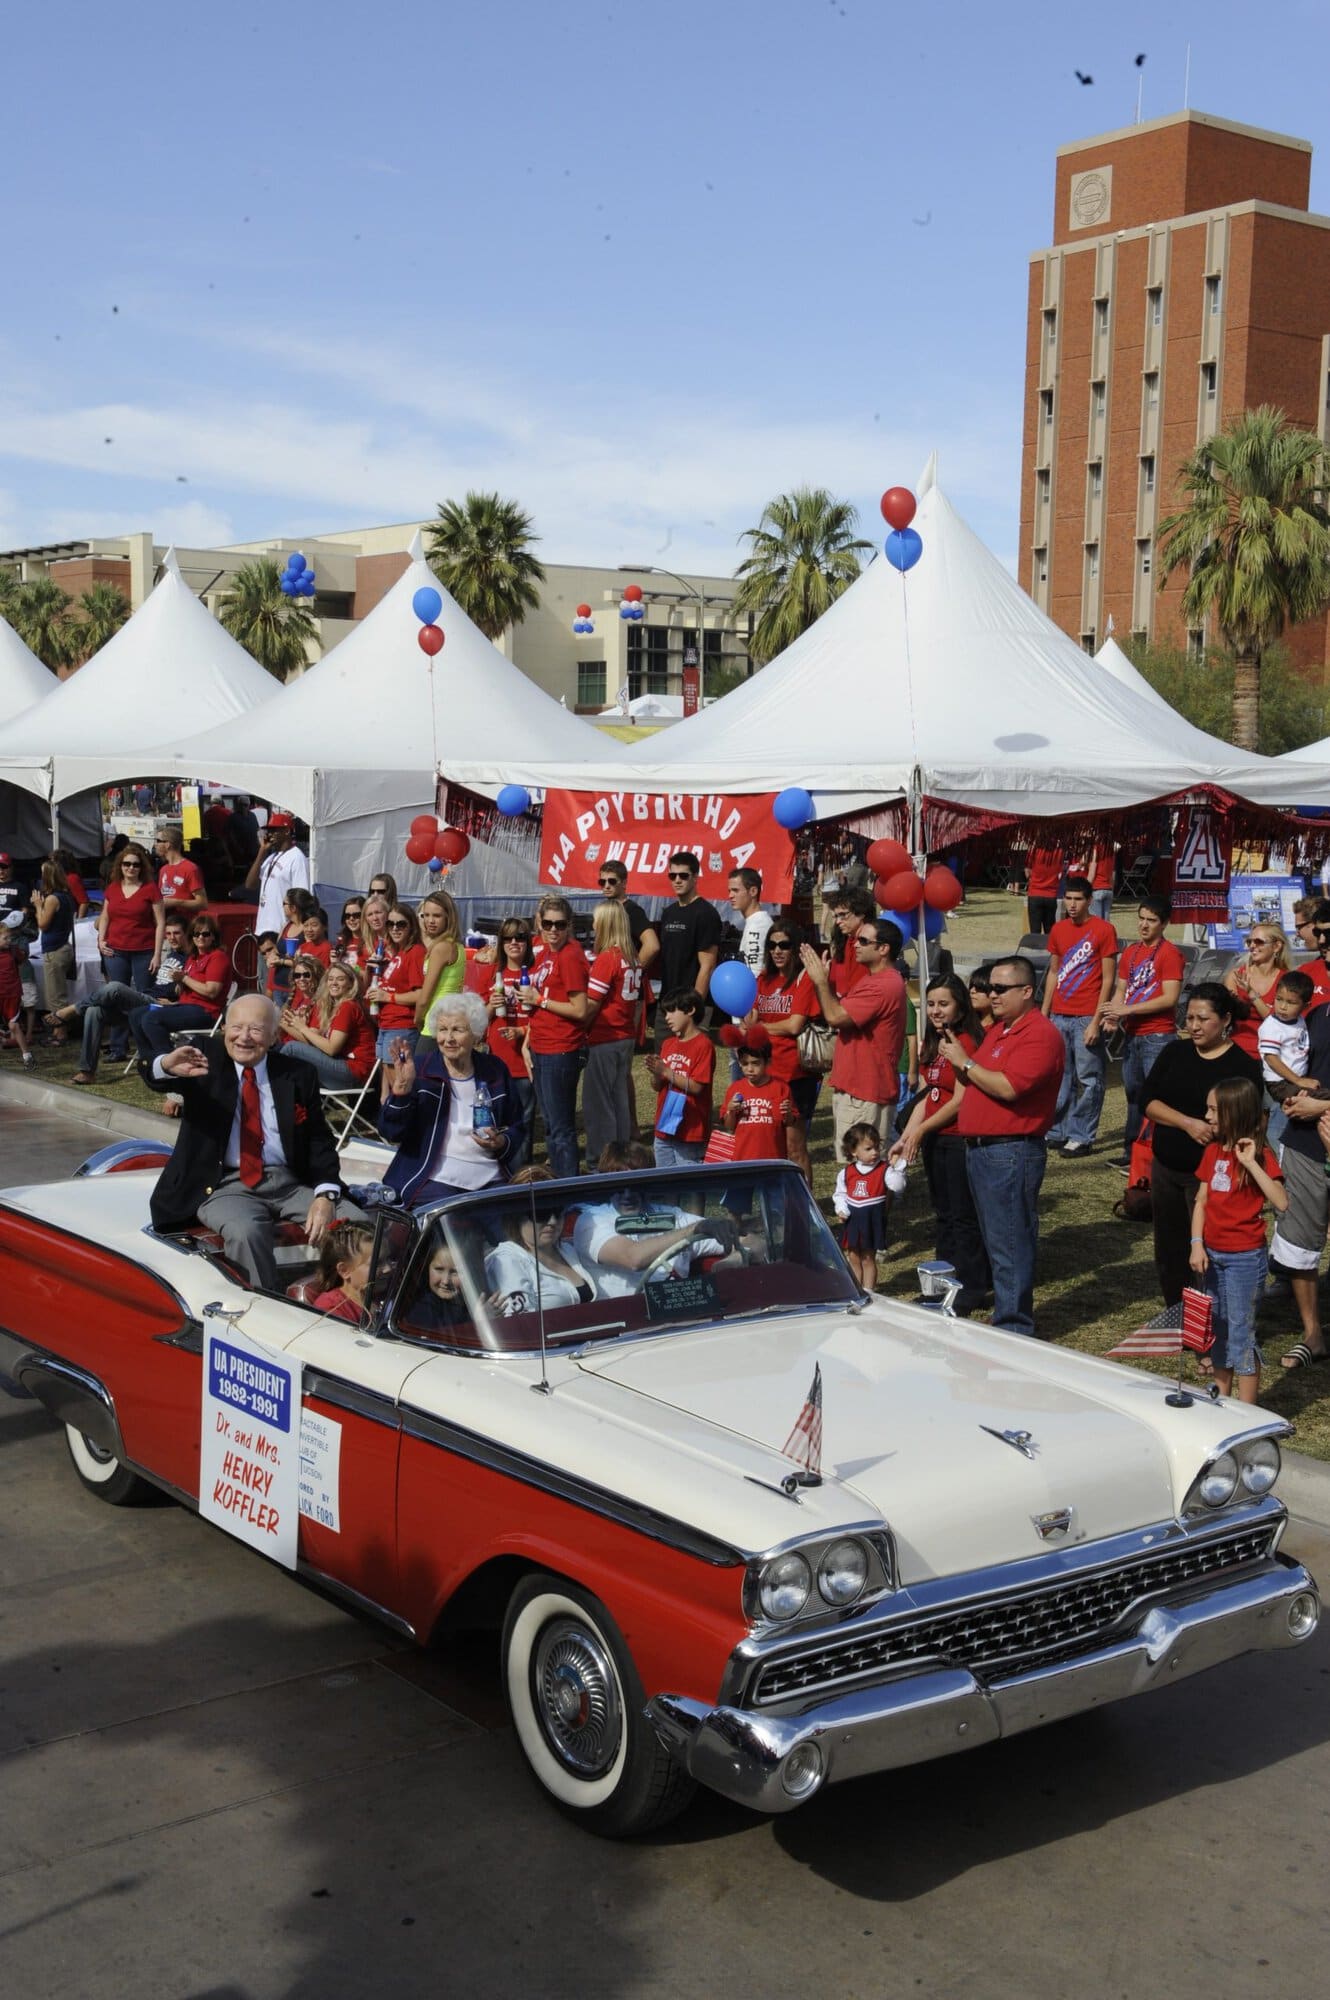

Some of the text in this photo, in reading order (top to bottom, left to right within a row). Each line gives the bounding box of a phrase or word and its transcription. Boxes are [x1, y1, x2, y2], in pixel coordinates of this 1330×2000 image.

[549, 792, 624, 884] HAPPY
[1176, 807, 1226, 883] A
[740, 1098, 772, 1109] RIZON
[852, 1180, 868, 1198] A
[214, 1347, 286, 1402] UA PRESIDENT
[218, 1378, 279, 1421] 1982-1991
[216, 1412, 280, 1466] Dr. and Mrs.
[223, 1450, 273, 1498] HENRY
[214, 1479, 280, 1536] KOFFLER
[317, 1505, 334, 1528] FORD
[322, 1493, 329, 1504] BY
